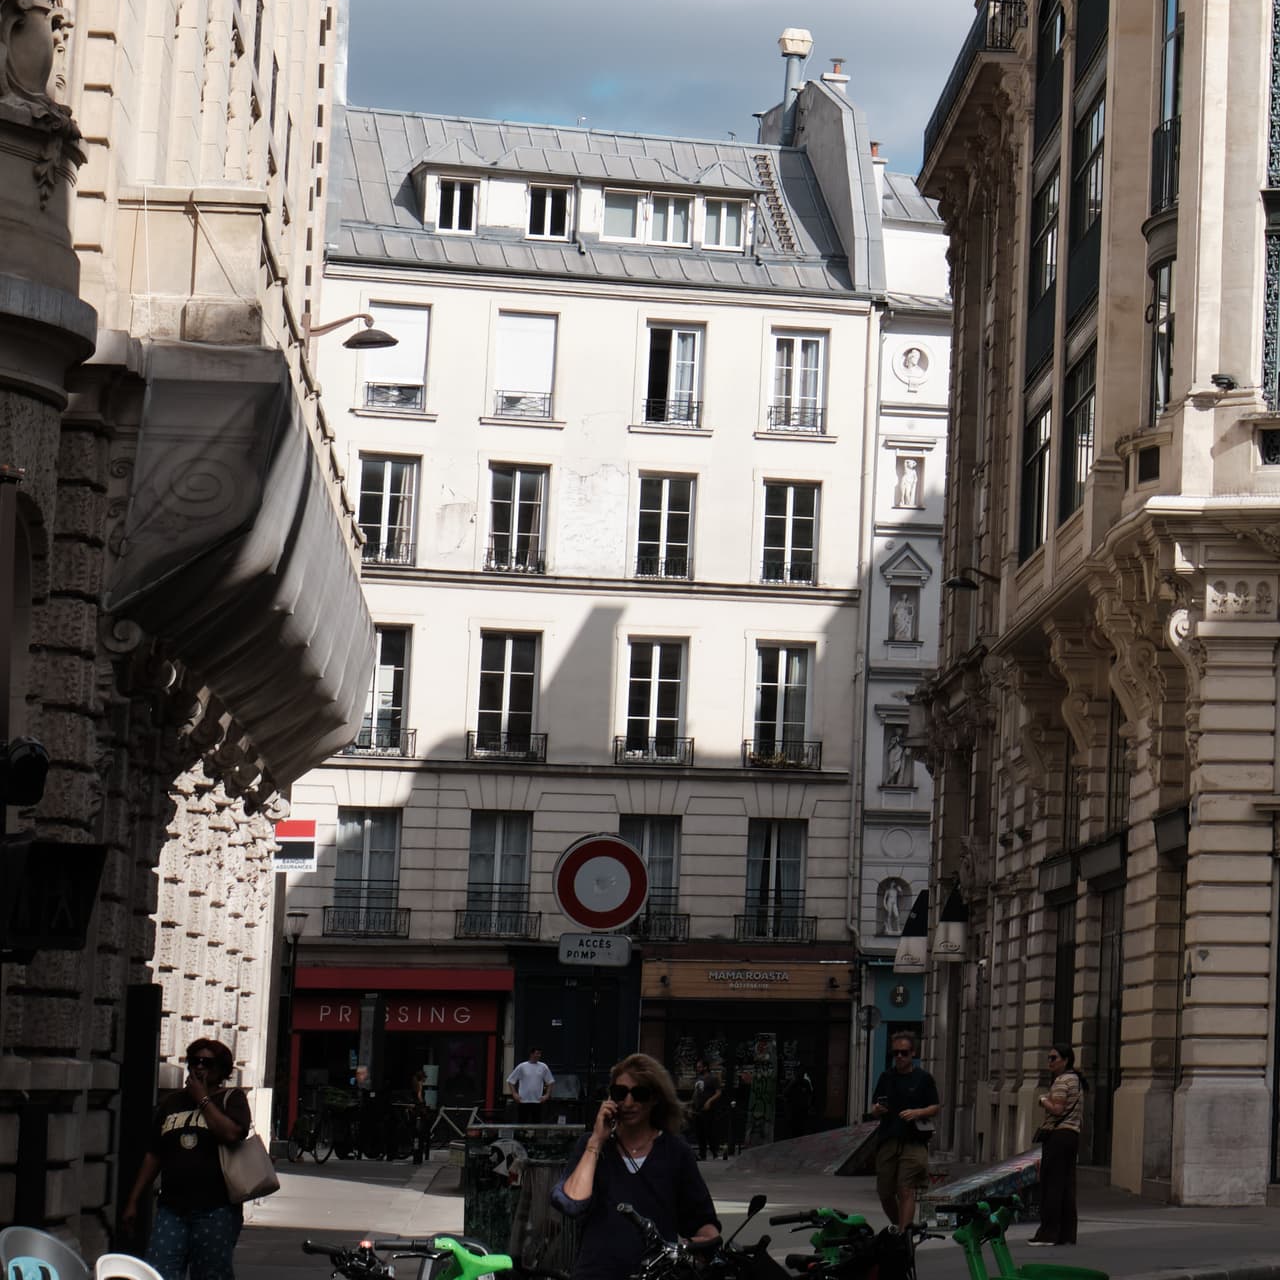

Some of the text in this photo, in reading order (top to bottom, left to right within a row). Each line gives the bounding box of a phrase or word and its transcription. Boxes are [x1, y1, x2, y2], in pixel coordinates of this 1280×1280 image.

[578, 938, 612, 949] ACCÈS
[708, 970, 790, 981] MAMA ROASTA
